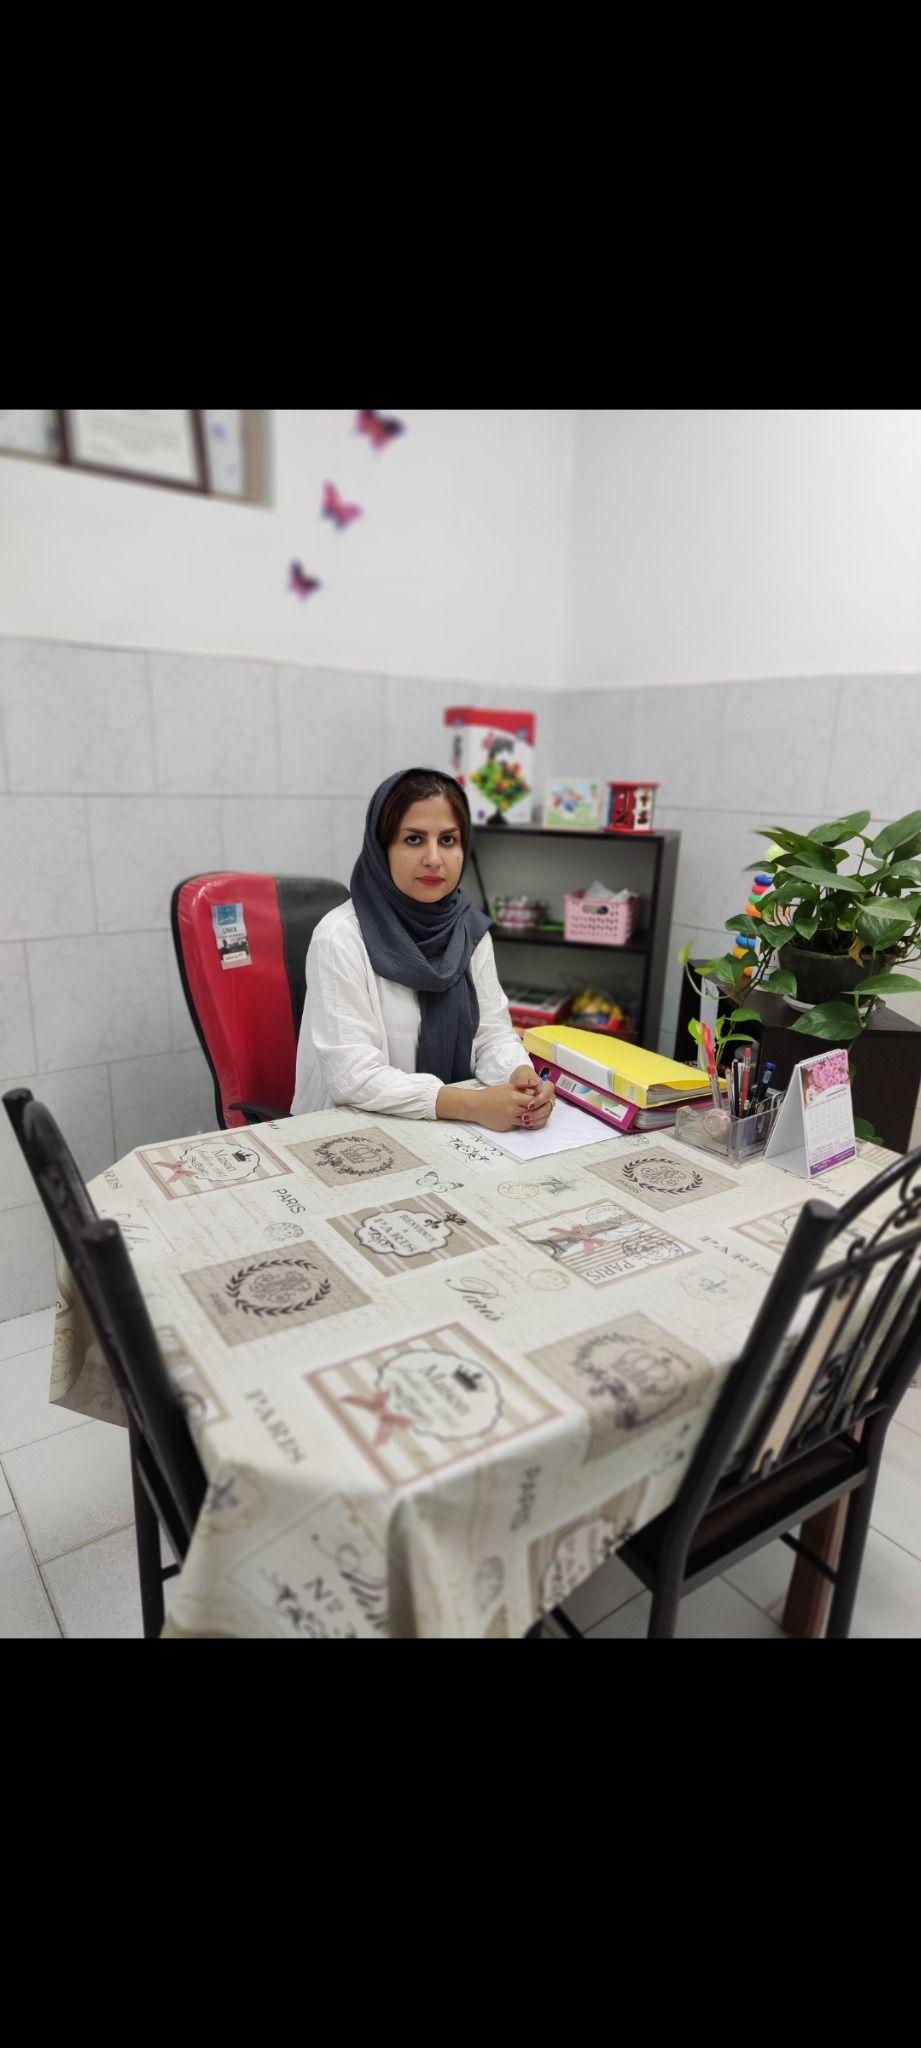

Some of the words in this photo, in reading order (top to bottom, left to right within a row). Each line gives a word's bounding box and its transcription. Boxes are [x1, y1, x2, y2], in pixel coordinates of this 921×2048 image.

[272, 1188, 306, 1214] PARIS
[374, 1218, 414, 1252] PARIS
[586, 1260, 635, 1280] PARIS
